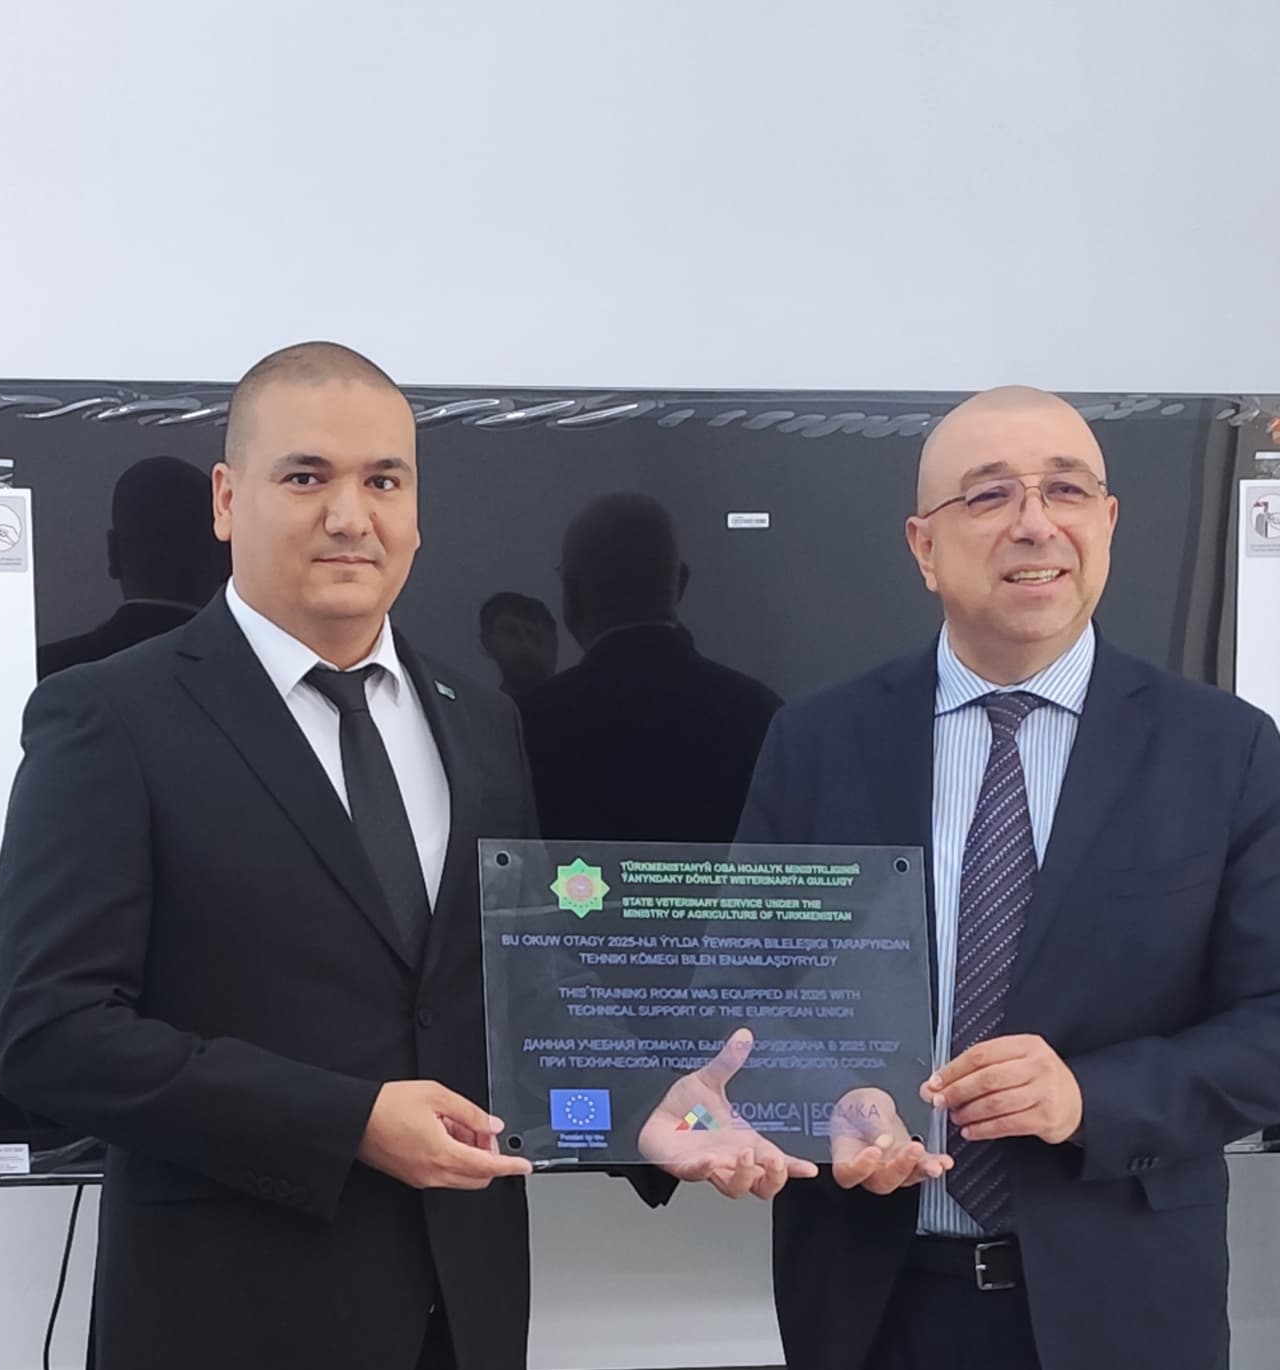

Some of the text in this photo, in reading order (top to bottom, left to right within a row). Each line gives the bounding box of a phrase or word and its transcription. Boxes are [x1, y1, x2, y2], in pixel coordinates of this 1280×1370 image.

[672, 910, 686, 918] OF
[760, 910, 773, 920] OF
[502, 935, 519, 946] BU
[522, 936, 560, 946] OKUW
[564, 936, 605, 946] OTAGY
[559, 987, 860, 1000] THIS TRAINING ROOM WAS EQUIPPED IN WITH
[567, 1004, 854, 1018] TECHNICAL SUPPORT OF THE EUROPEAN UNION
